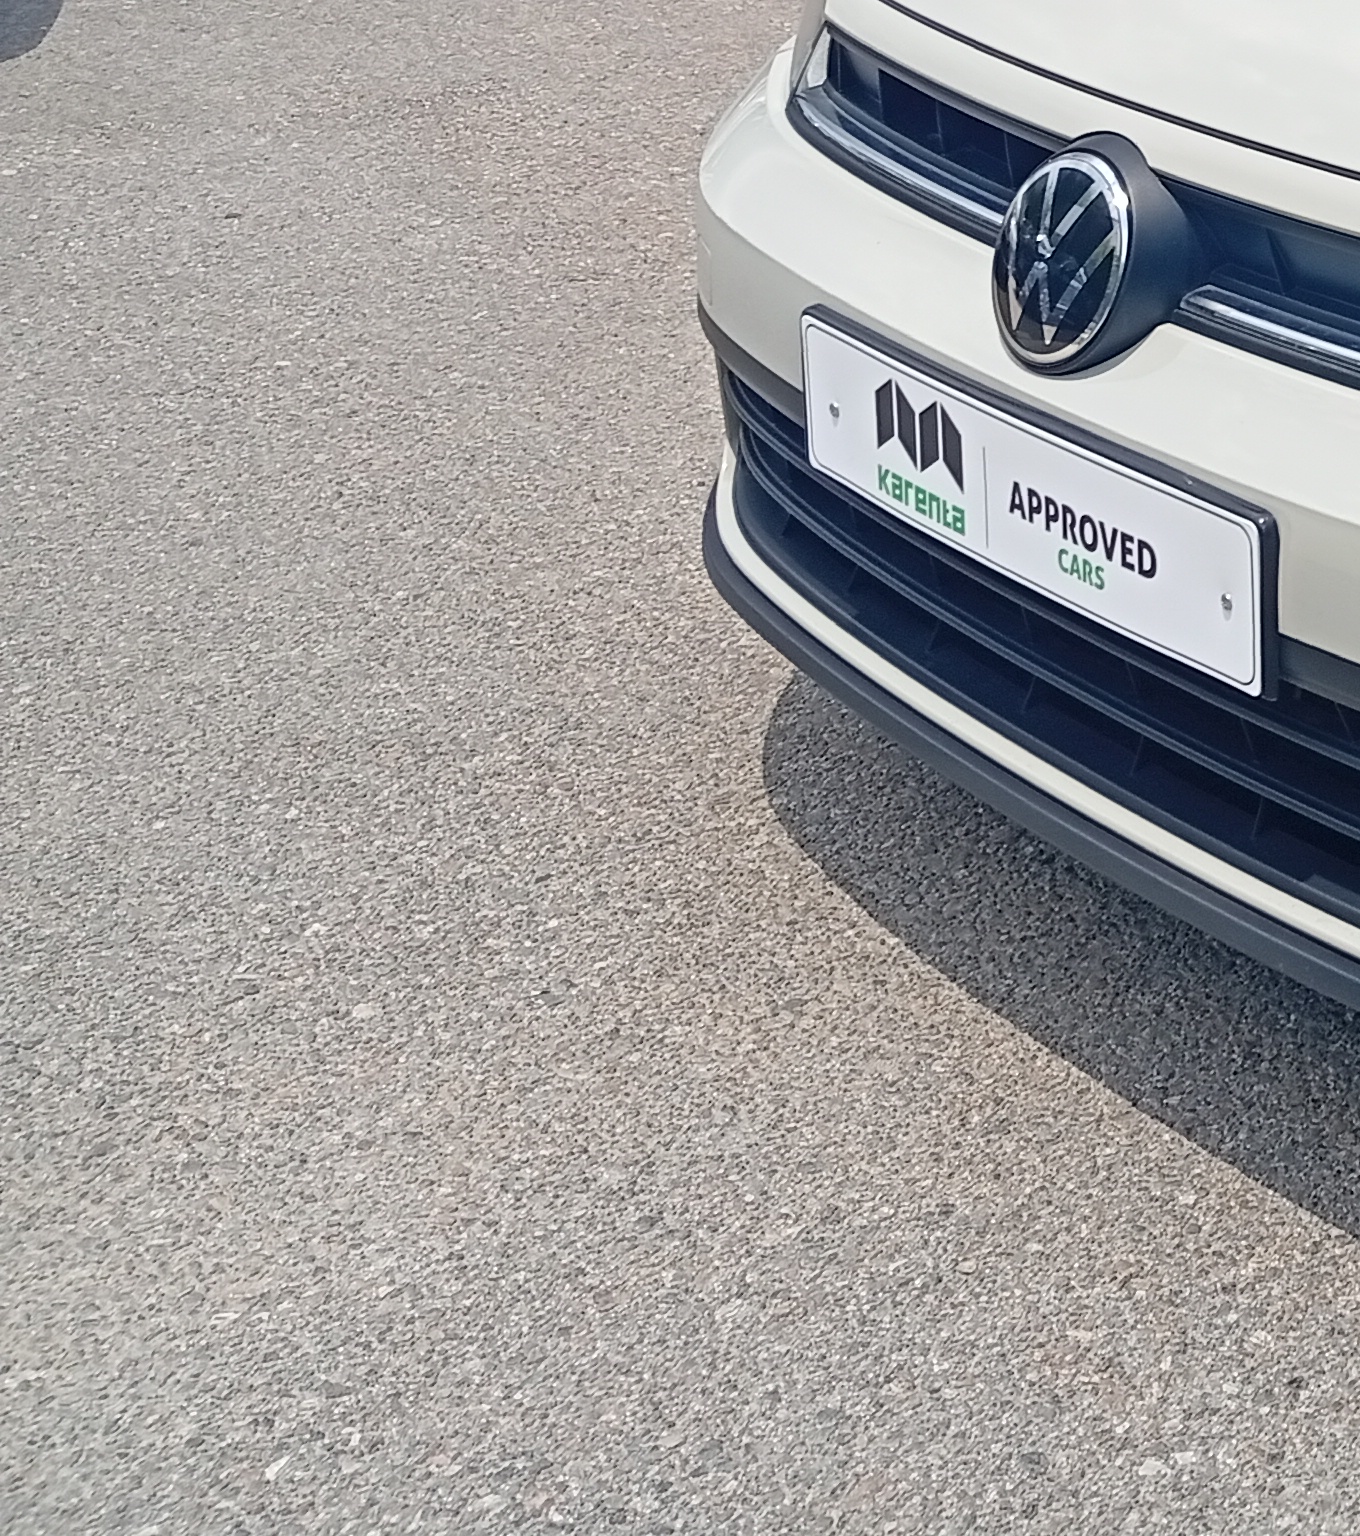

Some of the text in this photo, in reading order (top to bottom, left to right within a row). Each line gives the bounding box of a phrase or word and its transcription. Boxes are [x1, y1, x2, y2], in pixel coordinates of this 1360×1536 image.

[877, 463, 966, 537] karenta
[1008, 480, 1158, 580] APPROVED
[1057, 547, 1106, 591] CARS
